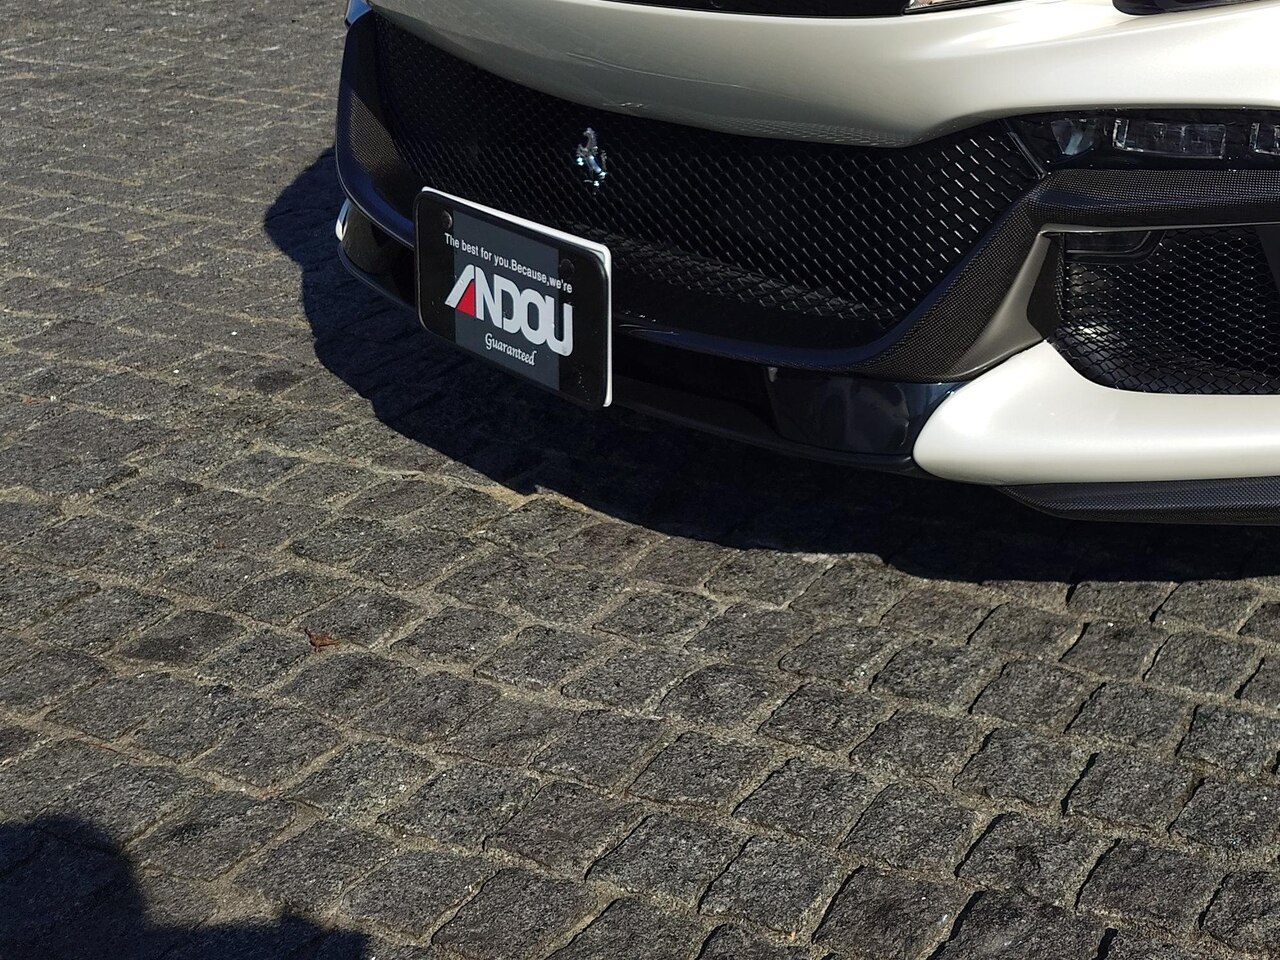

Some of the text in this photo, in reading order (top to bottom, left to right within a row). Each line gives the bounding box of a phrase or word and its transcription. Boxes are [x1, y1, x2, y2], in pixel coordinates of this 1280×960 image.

[444, 232, 460, 248] The
[461, 240, 479, 256] best
[480, 247, 492, 261] for
[444, 264, 573, 357] ANDOU
[484, 332, 537, 366] Guaranteed
